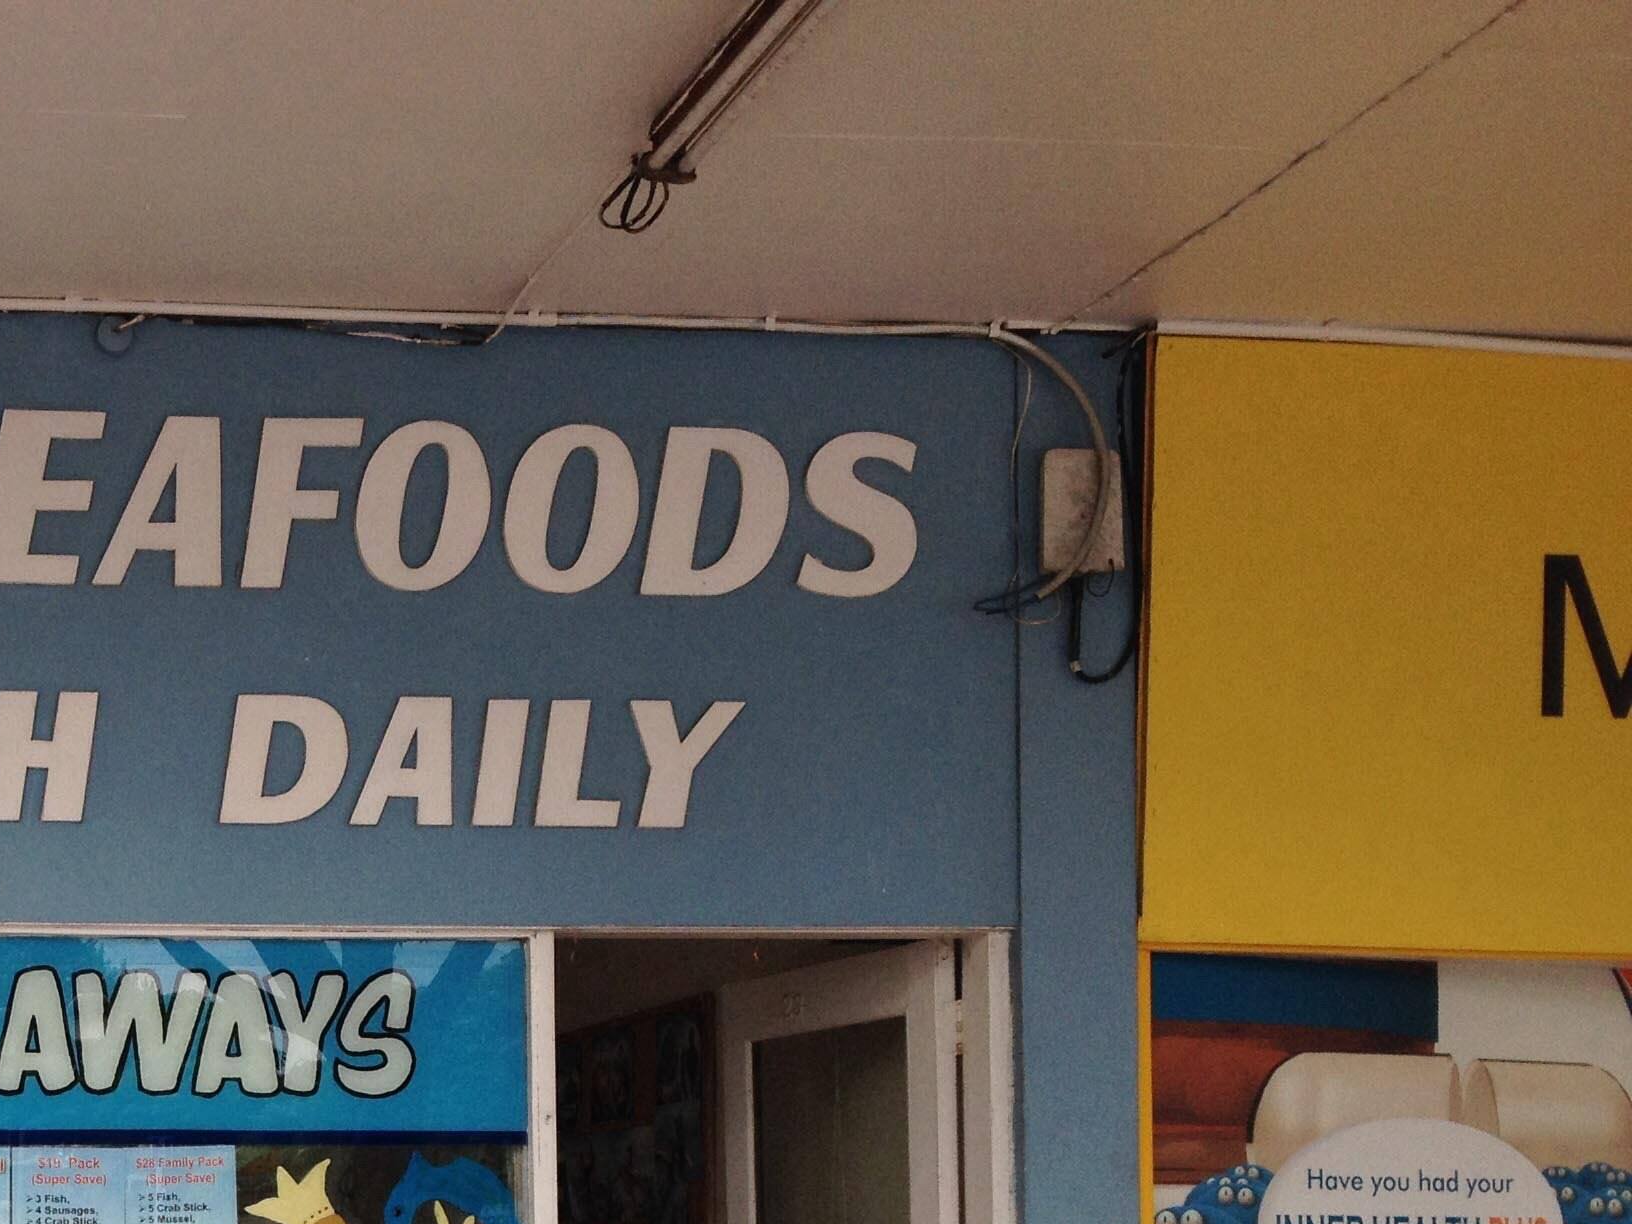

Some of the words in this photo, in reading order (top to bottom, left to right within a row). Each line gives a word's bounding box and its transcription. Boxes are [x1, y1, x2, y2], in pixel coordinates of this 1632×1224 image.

[220, 692, 745, 831] DAILY
[198, 1157, 224, 1167] Pack
[1306, 1168, 1363, 1192] Have
[1371, 1175, 1410, 1197] you
[1418, 1169, 1459, 1193] had
[1466, 1175, 1513, 1198] your
[156, 1203, 181, 1212] Crab
